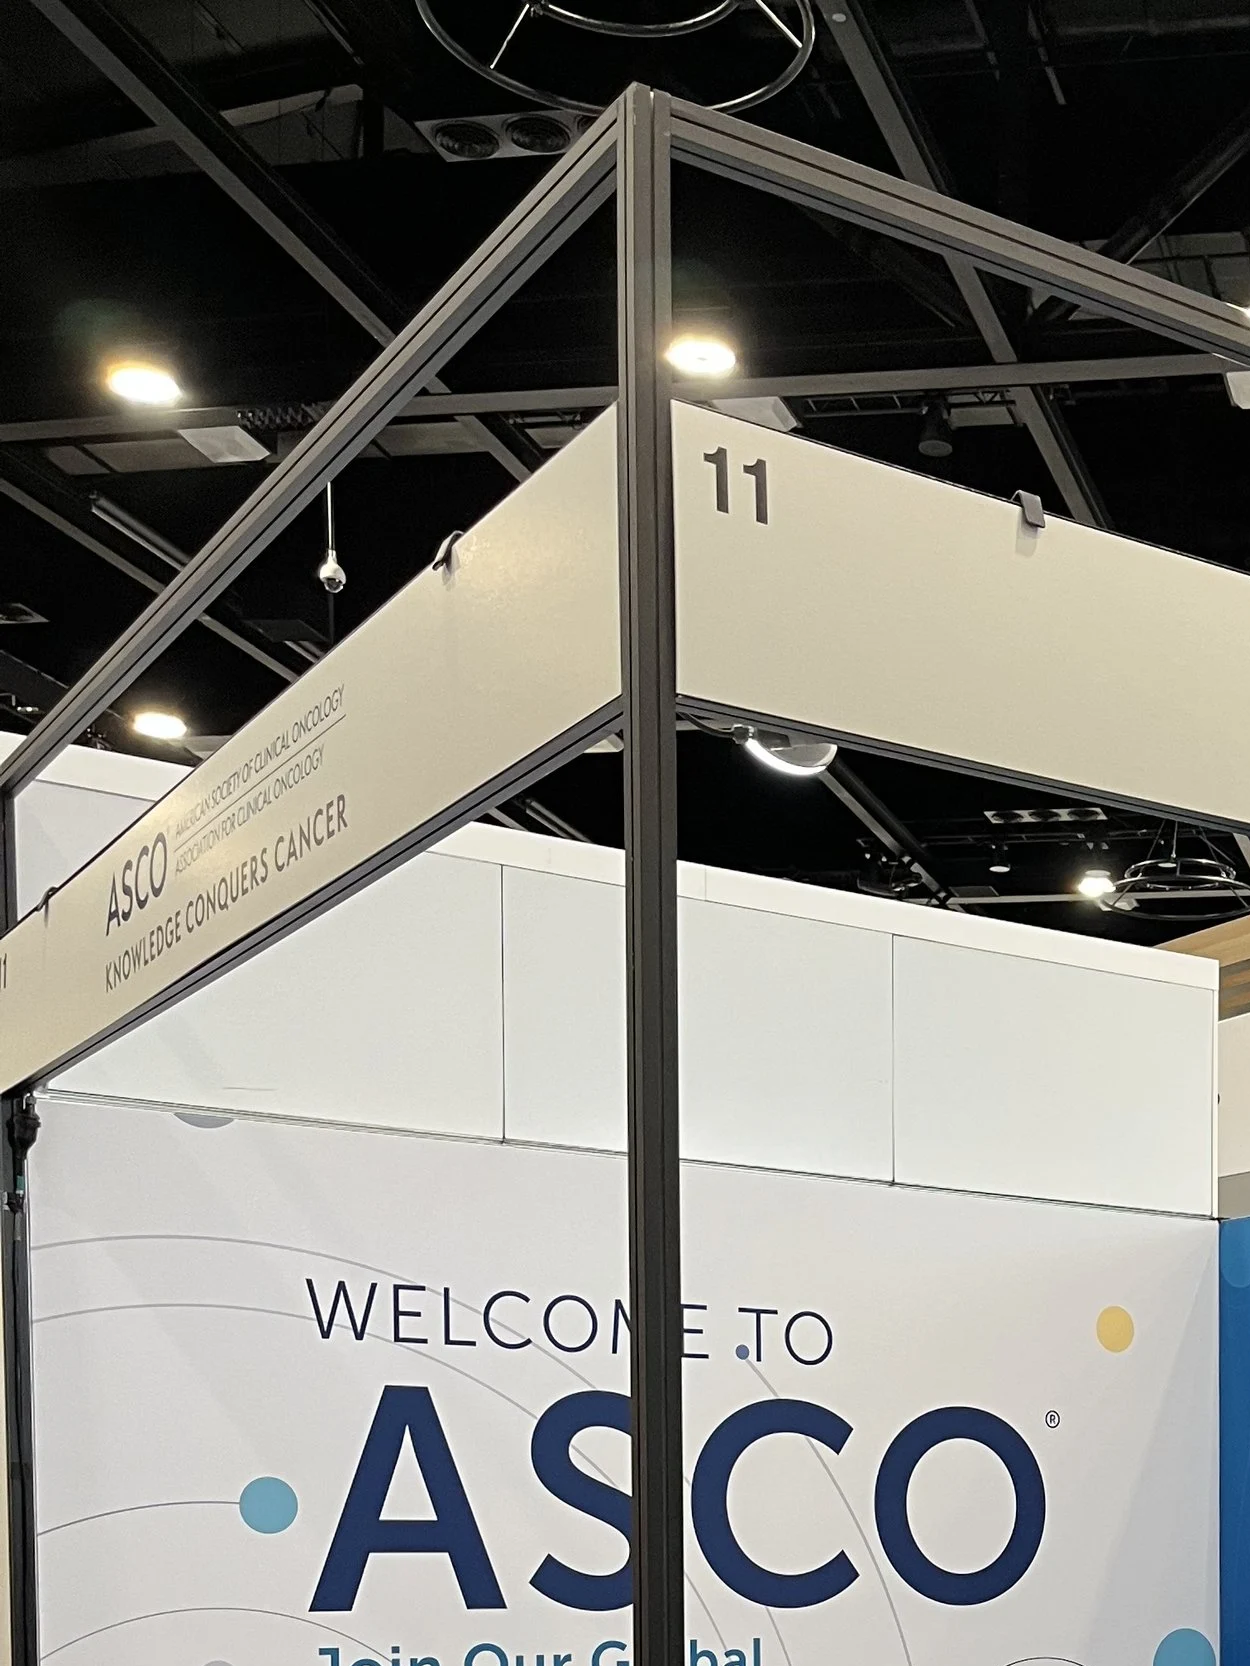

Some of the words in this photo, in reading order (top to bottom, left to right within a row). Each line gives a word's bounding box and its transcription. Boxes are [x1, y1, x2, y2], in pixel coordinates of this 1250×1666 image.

[703, 446, 768, 525] 11
[175, 796, 211, 839] AMERICAN
[211, 770, 241, 810] SOCIETY
[242, 758, 253, 784] OF
[253, 730, 290, 774] CLINICAL
[292, 684, 345, 743] ONCOLOGY
[175, 823, 221, 876] ASSOCIATION
[221, 812, 236, 840] FOR
[237, 785, 272, 827] CLINICAL
[273, 743, 325, 800] ONCOLOGY
[105, 910, 182, 993] KNOWLEDGE
[185, 848, 269, 934] CONQUERS
[274, 793, 348, 872] CANCER
[737, 1307, 834, 1367] TO
